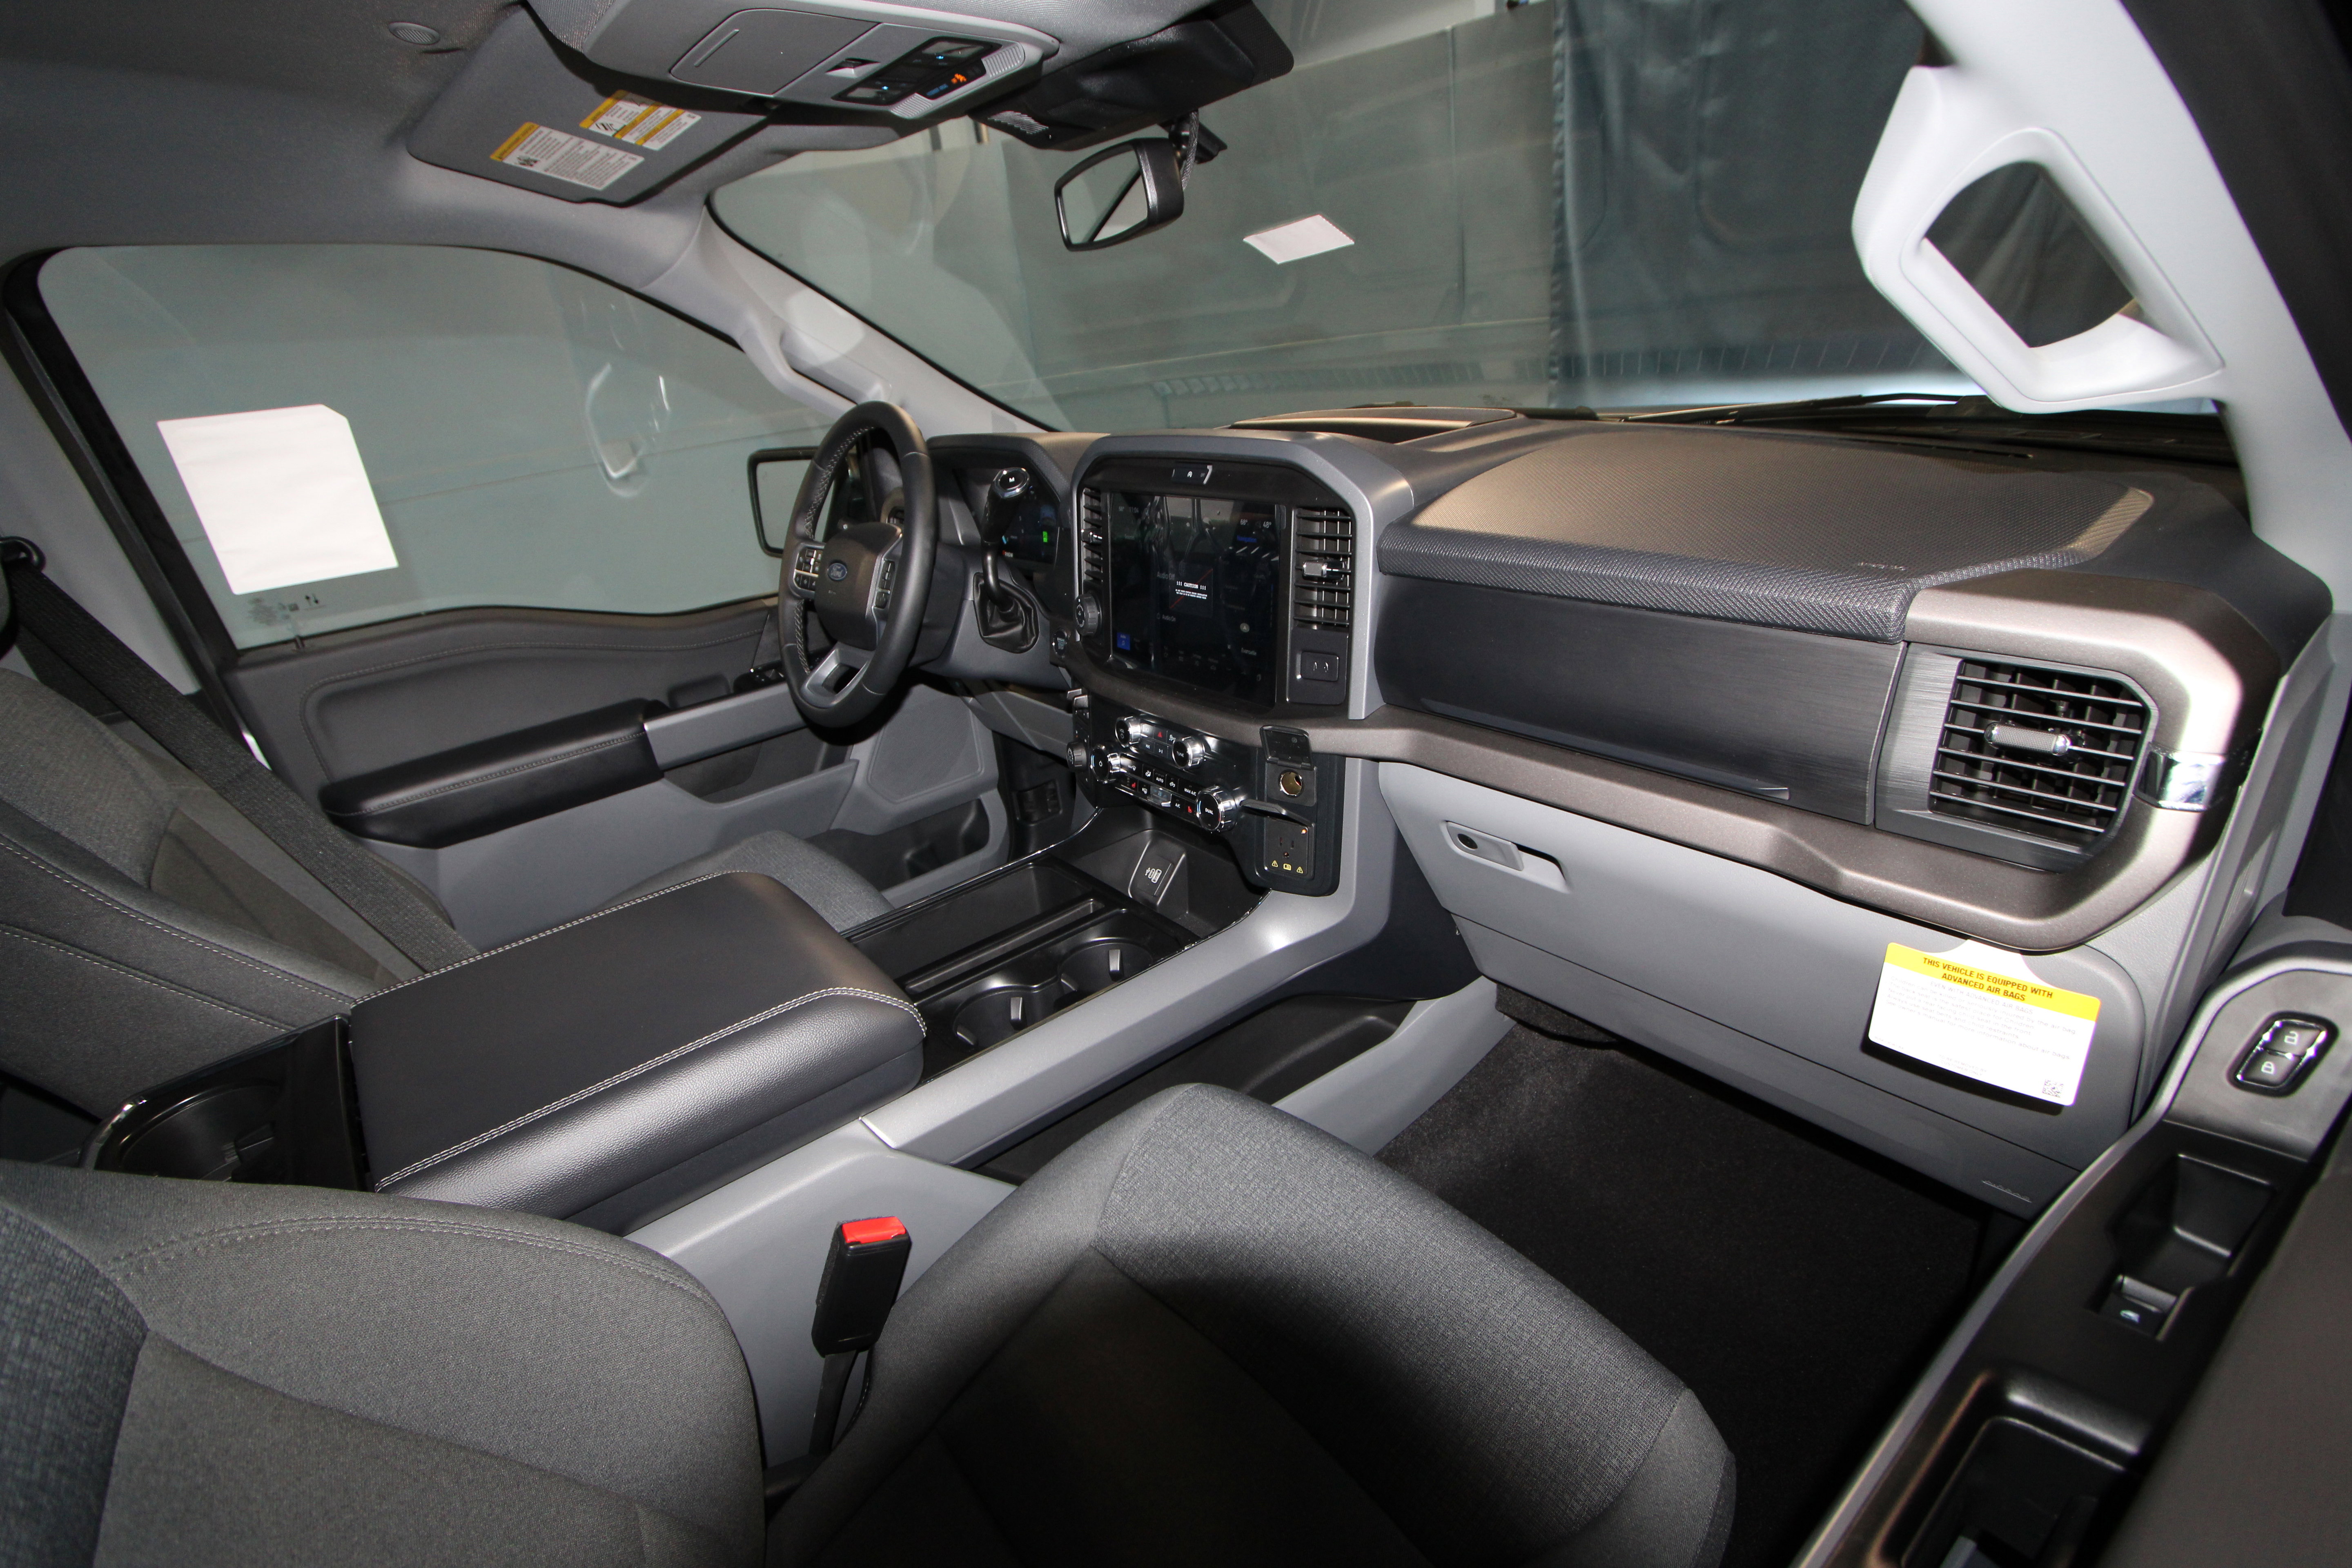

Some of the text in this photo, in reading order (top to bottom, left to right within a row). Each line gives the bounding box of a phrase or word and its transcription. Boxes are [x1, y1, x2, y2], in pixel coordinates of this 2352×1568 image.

[831, 565, 843, 577] Ford
[1923, 957, 2053, 999] THIS VEHICLE IS EQUIPPED WITH
[1942, 973, 2026, 1002] ADVANCED AIR BAGS
[1887, 993, 1907, 1004] Always
[1936, 1010, 1952, 1019] belts
[1968, 1020, 1984, 1029] child
[1889, 988, 1905, 997] Never
[1937, 1004, 1957, 1015] facing
[1958, 1011, 1975, 1019] child
[1891, 976, 1915, 987] Children
[1940, 992, 1956, 1001] killed
[1967, 1000, 1998, 1013] seriously
[2000, 1010, 2025, 1020] injured
[1902, 986, 1915, 994] back
[1951, 1002, 1971, 1012] safest
[1973, 1009, 1991, 1018] place
[1930, 981, 1946, 990] EVEN
[1948, 987, 1964, 995] WITH
[1966, 992, 2000, 1005] ADVANCED
[2015, 1005, 2033, 1015] BAGS
[1923, 1013, 1945, 1023] manual
[1958, 1024, 1975, 1033] more
[1977, 1030, 2016, 1045] information
[2018, 1042, 2039, 1051] about
